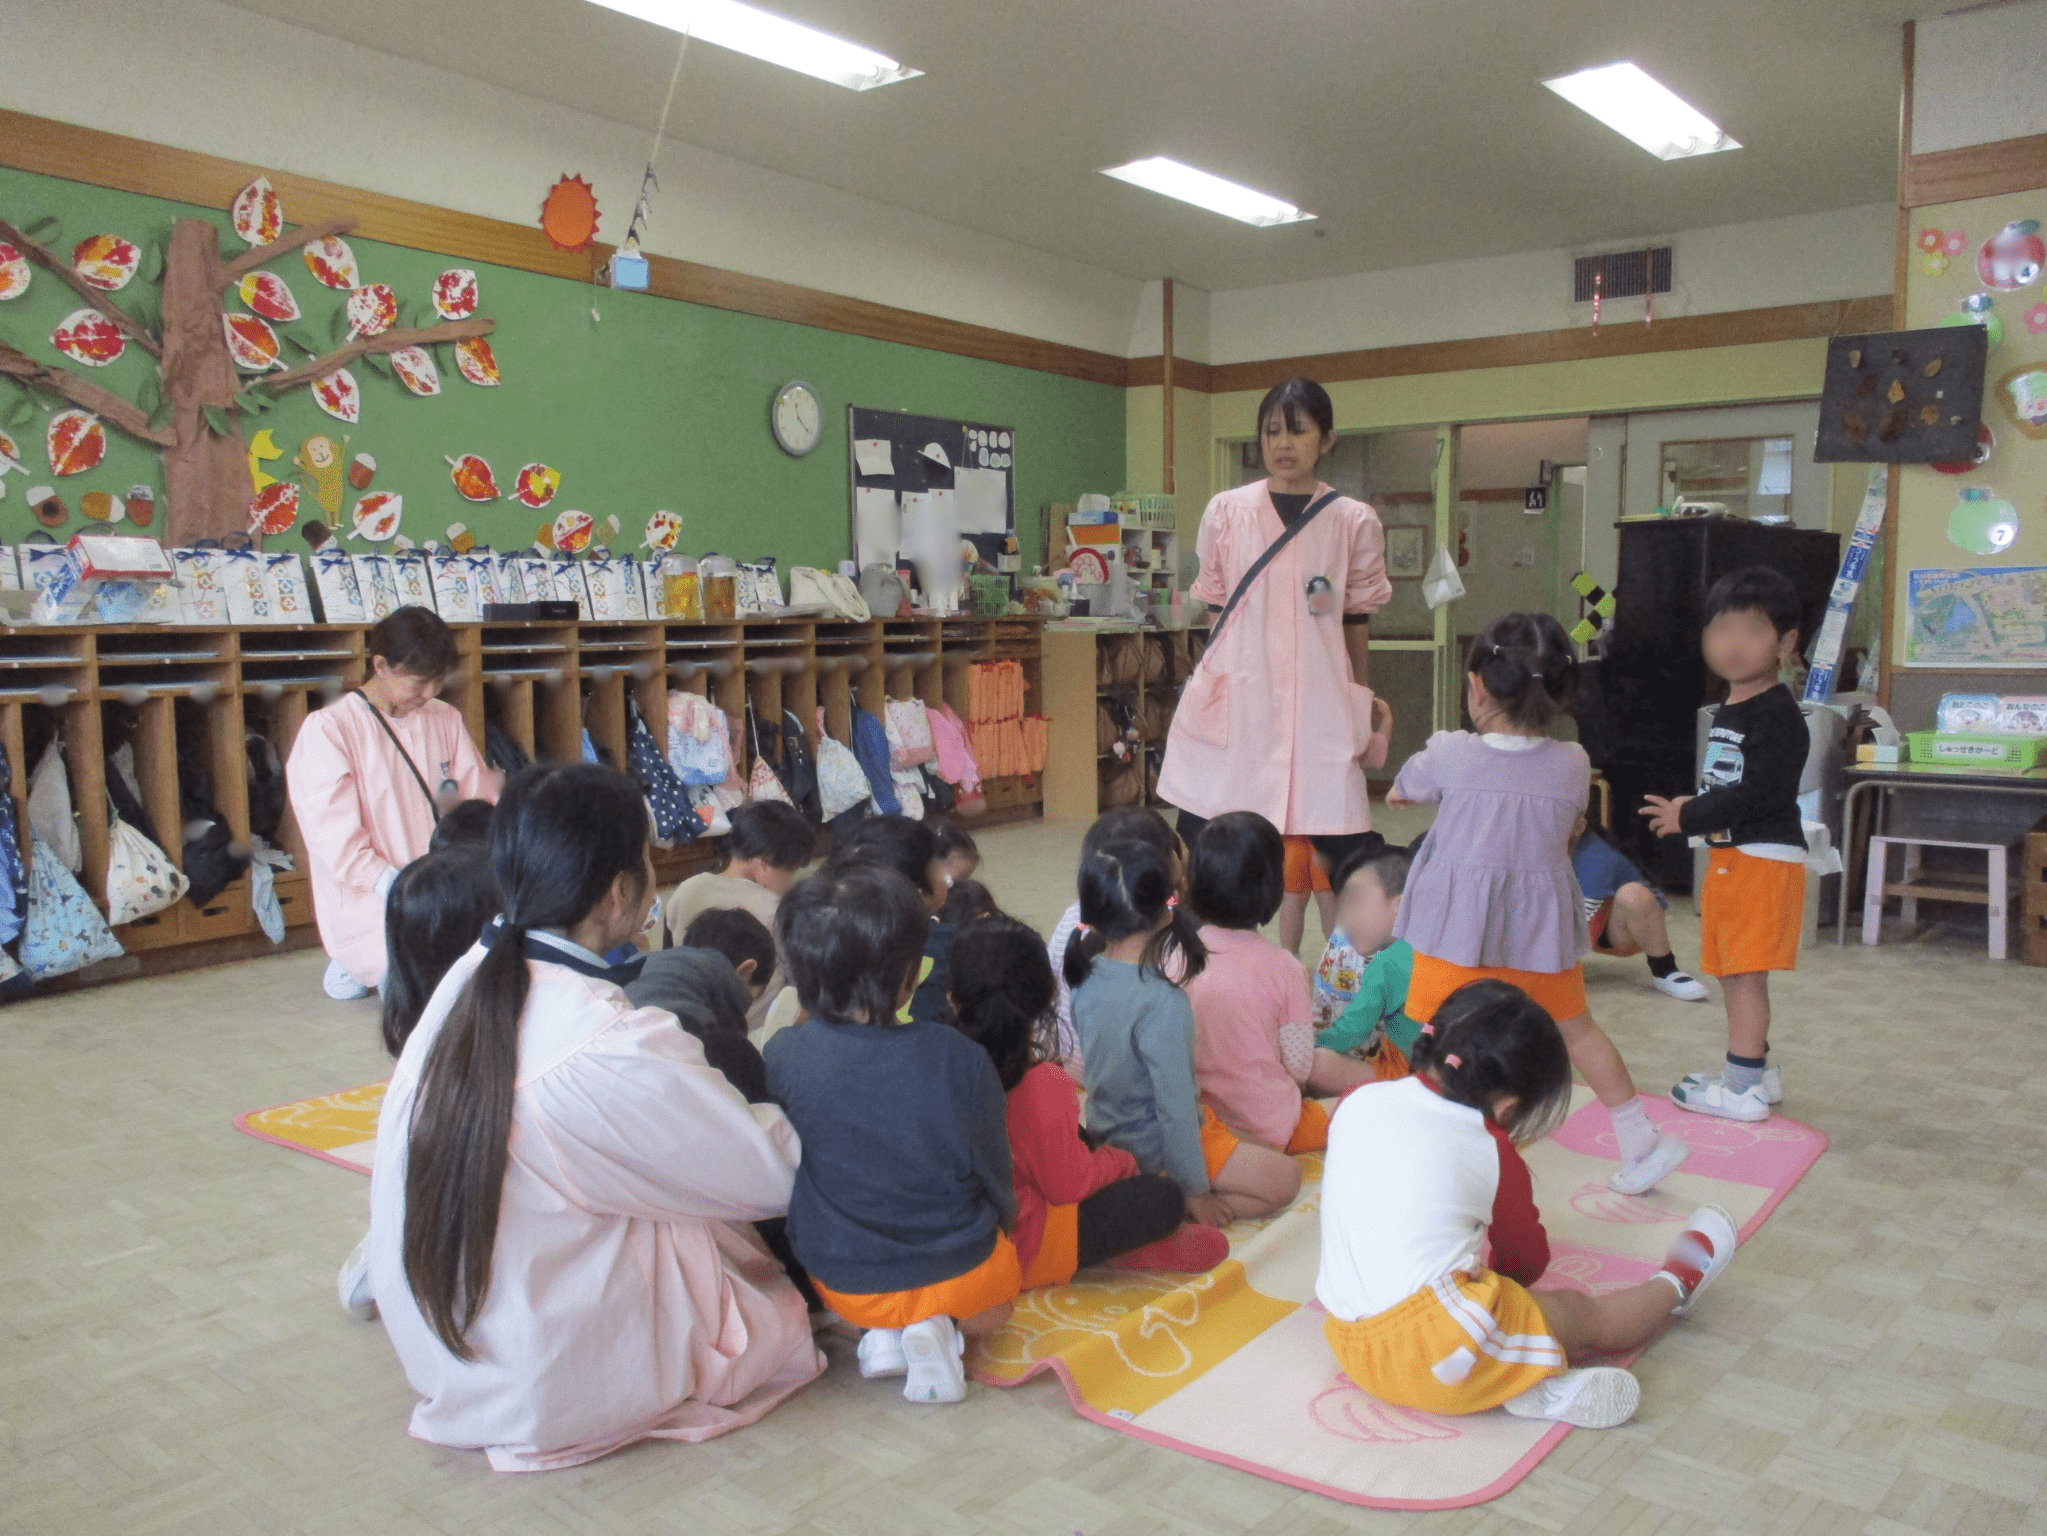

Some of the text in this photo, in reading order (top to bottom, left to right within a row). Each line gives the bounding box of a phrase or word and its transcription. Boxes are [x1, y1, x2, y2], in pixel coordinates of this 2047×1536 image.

[1997, 529, 2006, 542] 7
[1939, 744, 1999, 755] しゅっせきかーど
